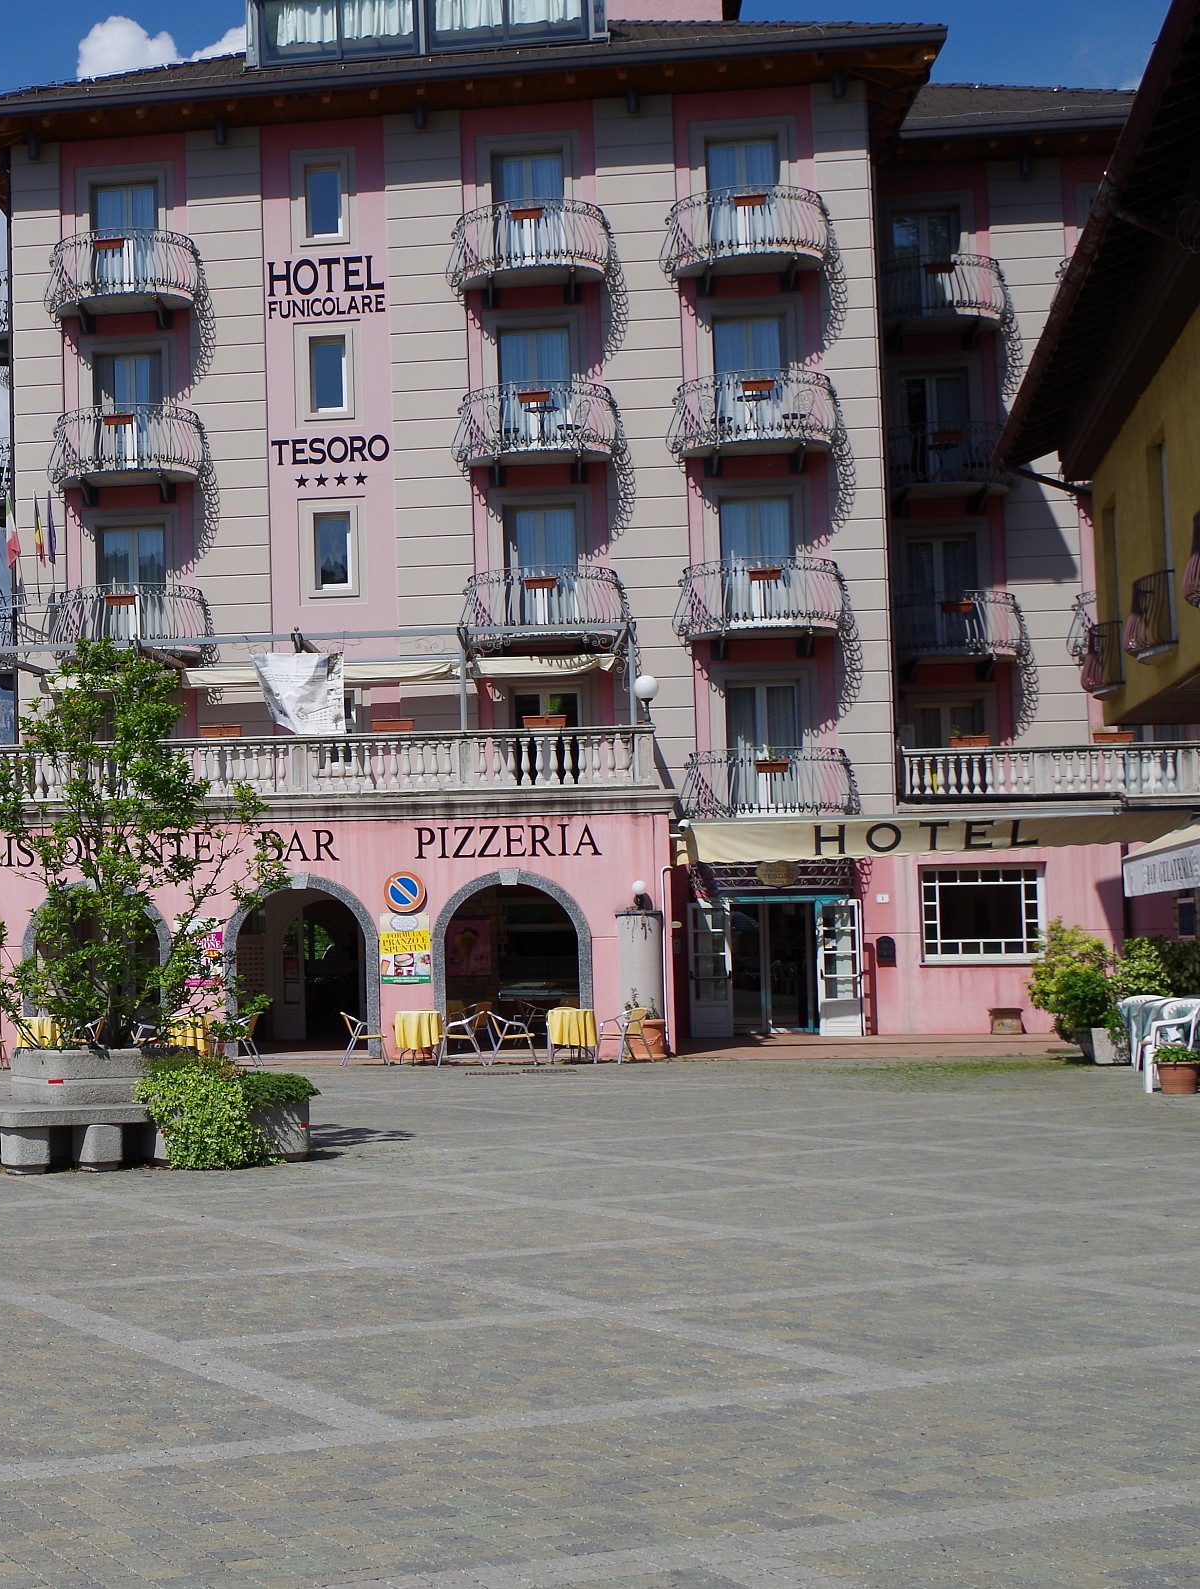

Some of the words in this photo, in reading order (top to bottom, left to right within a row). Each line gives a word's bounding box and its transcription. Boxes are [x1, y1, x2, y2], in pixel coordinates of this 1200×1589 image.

[267, 255, 385, 297] HOTEL
[268, 294, 386, 319] FUNICOLARE
[271, 434, 390, 466] TESORO
[258, 829, 340, 862] BAR
[414, 823, 603, 860] PIZZERIA
[813, 819, 1039, 856] HOTEL
[382, 937, 419, 946] PRANZO
[384, 944, 428, 953] SPUNTINI
[387, 930, 422, 939] FORMULA
